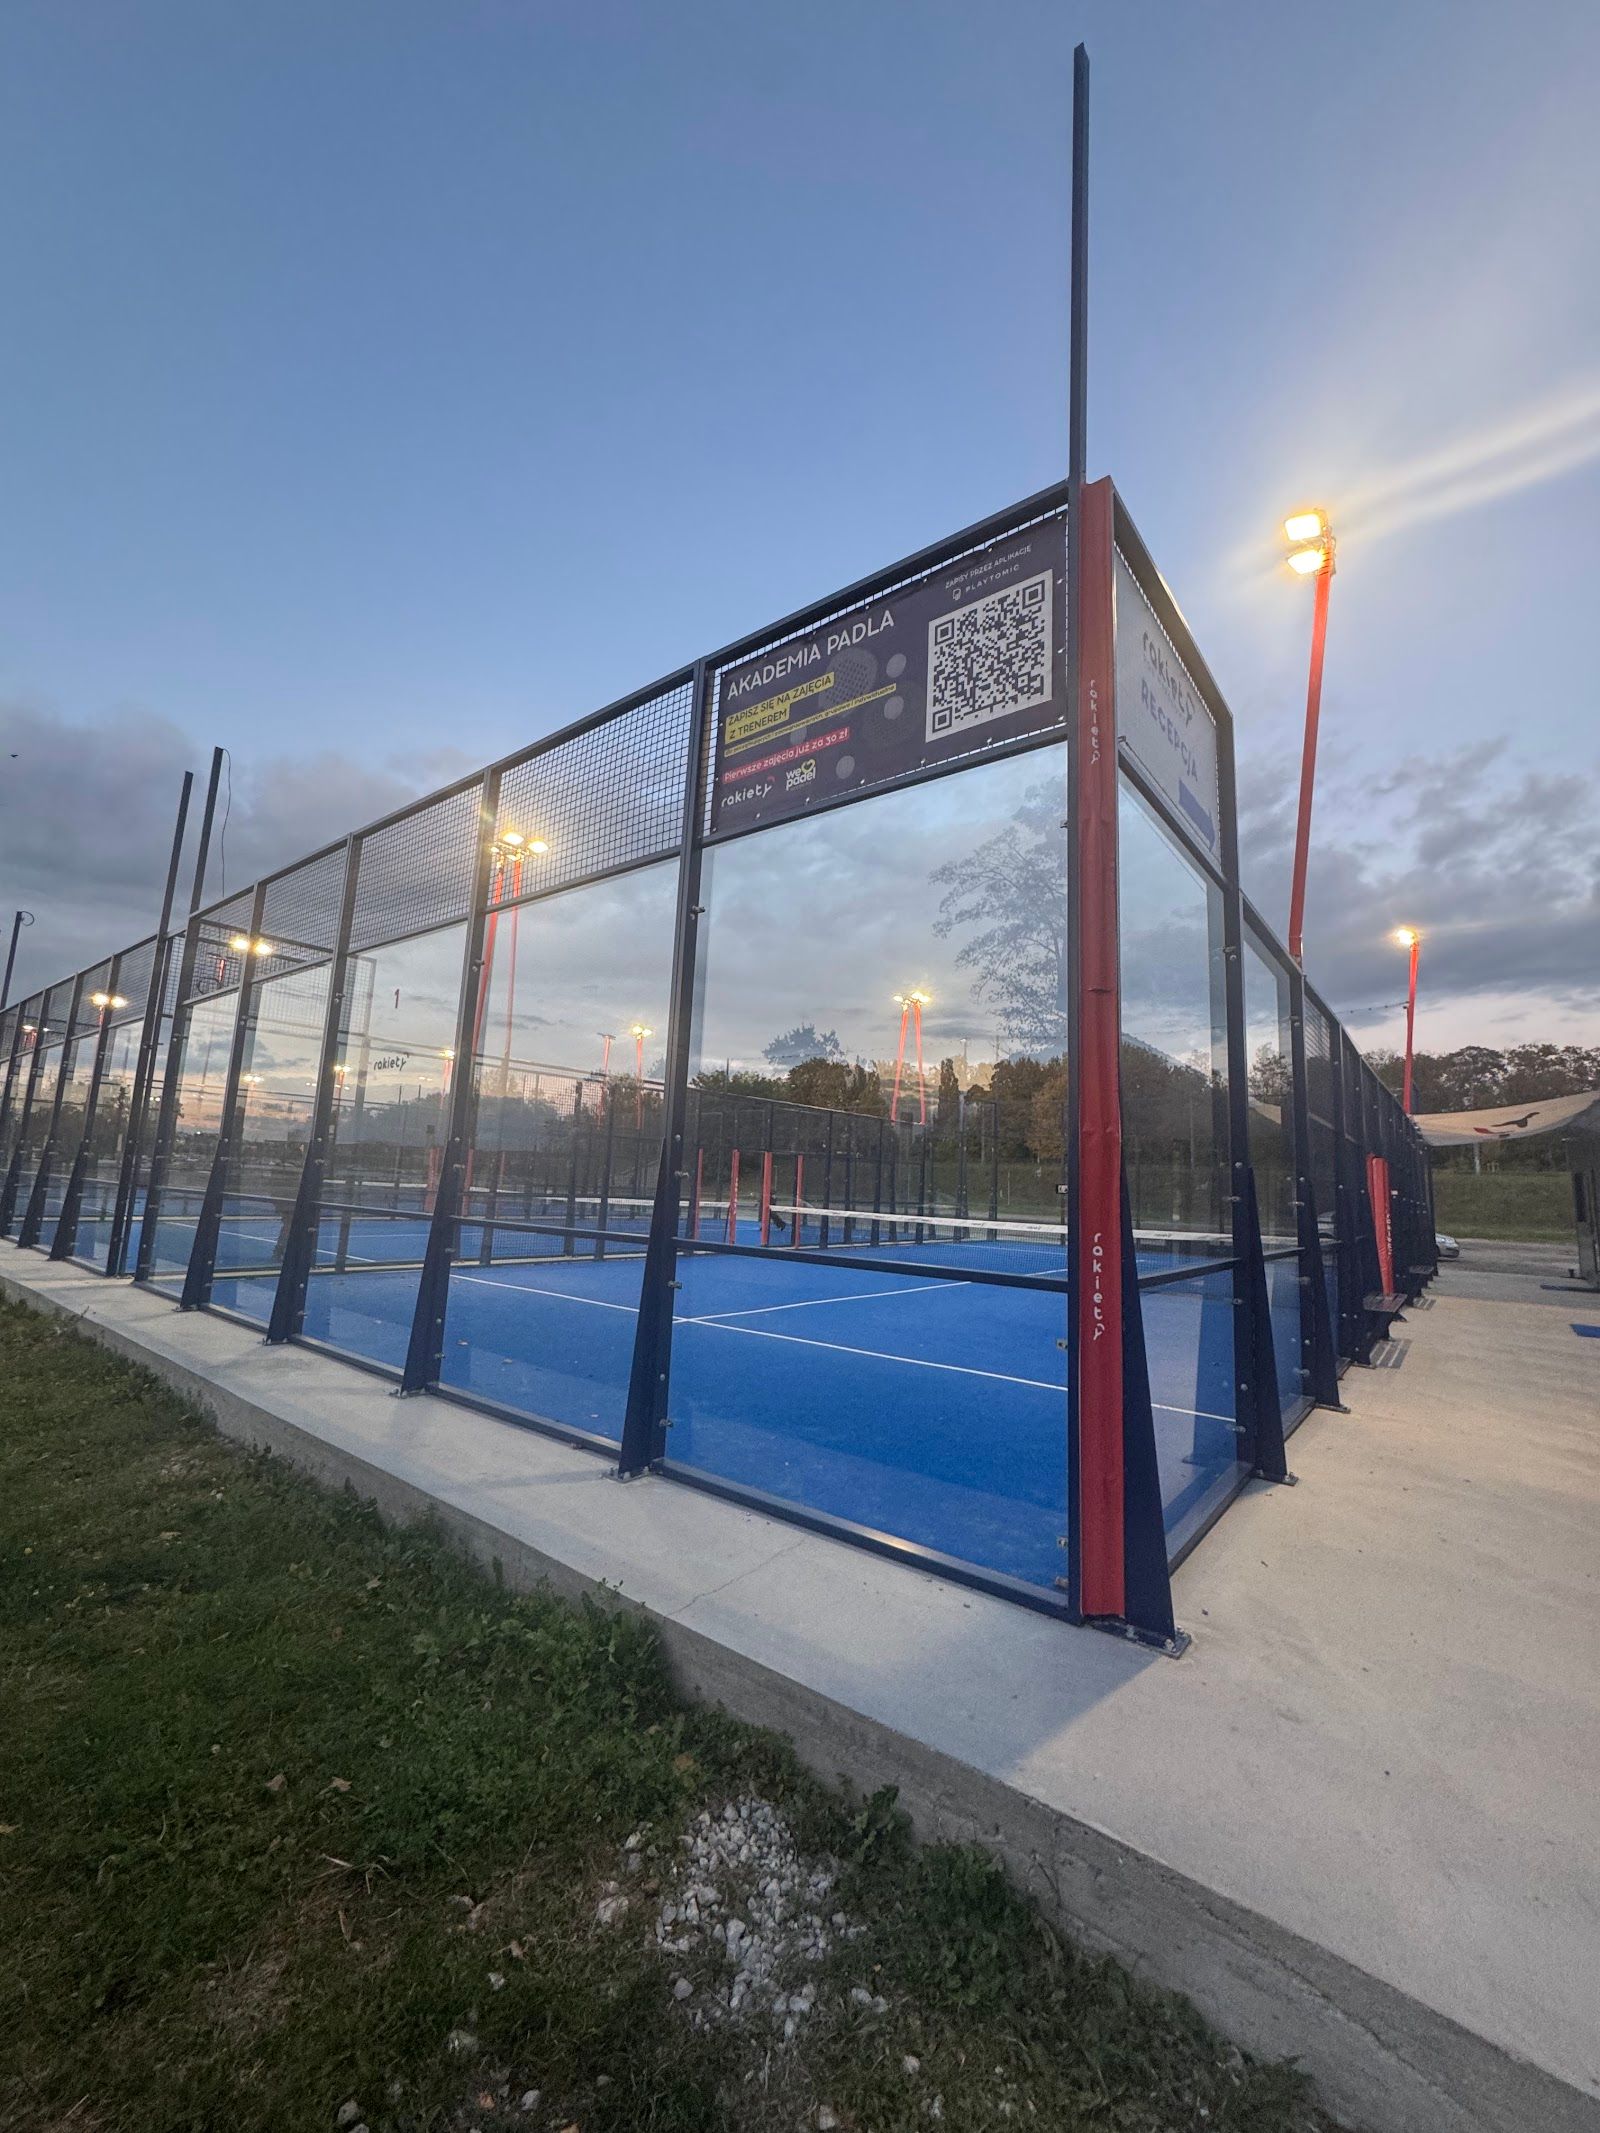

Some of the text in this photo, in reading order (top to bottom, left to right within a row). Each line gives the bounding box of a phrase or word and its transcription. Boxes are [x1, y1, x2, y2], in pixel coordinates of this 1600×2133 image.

[945, 572, 969, 589] ZAPISY
[970, 562, 993, 578] PRZEZ
[965, 564, 1020, 592] PLAYTOMIC
[727, 609, 895, 701] AKADEMIA PADLA
[1142, 630, 1195, 728] rakiety
[728, 675, 832, 726] ZAPISZ SIĘ NA ZAJĘCIA
[729, 708, 788, 740] Z TRENEREM
[1090, 679, 1101, 765] rakiety
[724, 729, 848, 781] Pierwsze zajęcia już za 30 zł
[1141, 677, 1198, 782] RECEPCJA
[721, 776, 775, 808] rakiety
[785, 768, 801, 779] we
[785, 766, 816, 791] padel
[1092, 1232, 1105, 1341] rakiety
